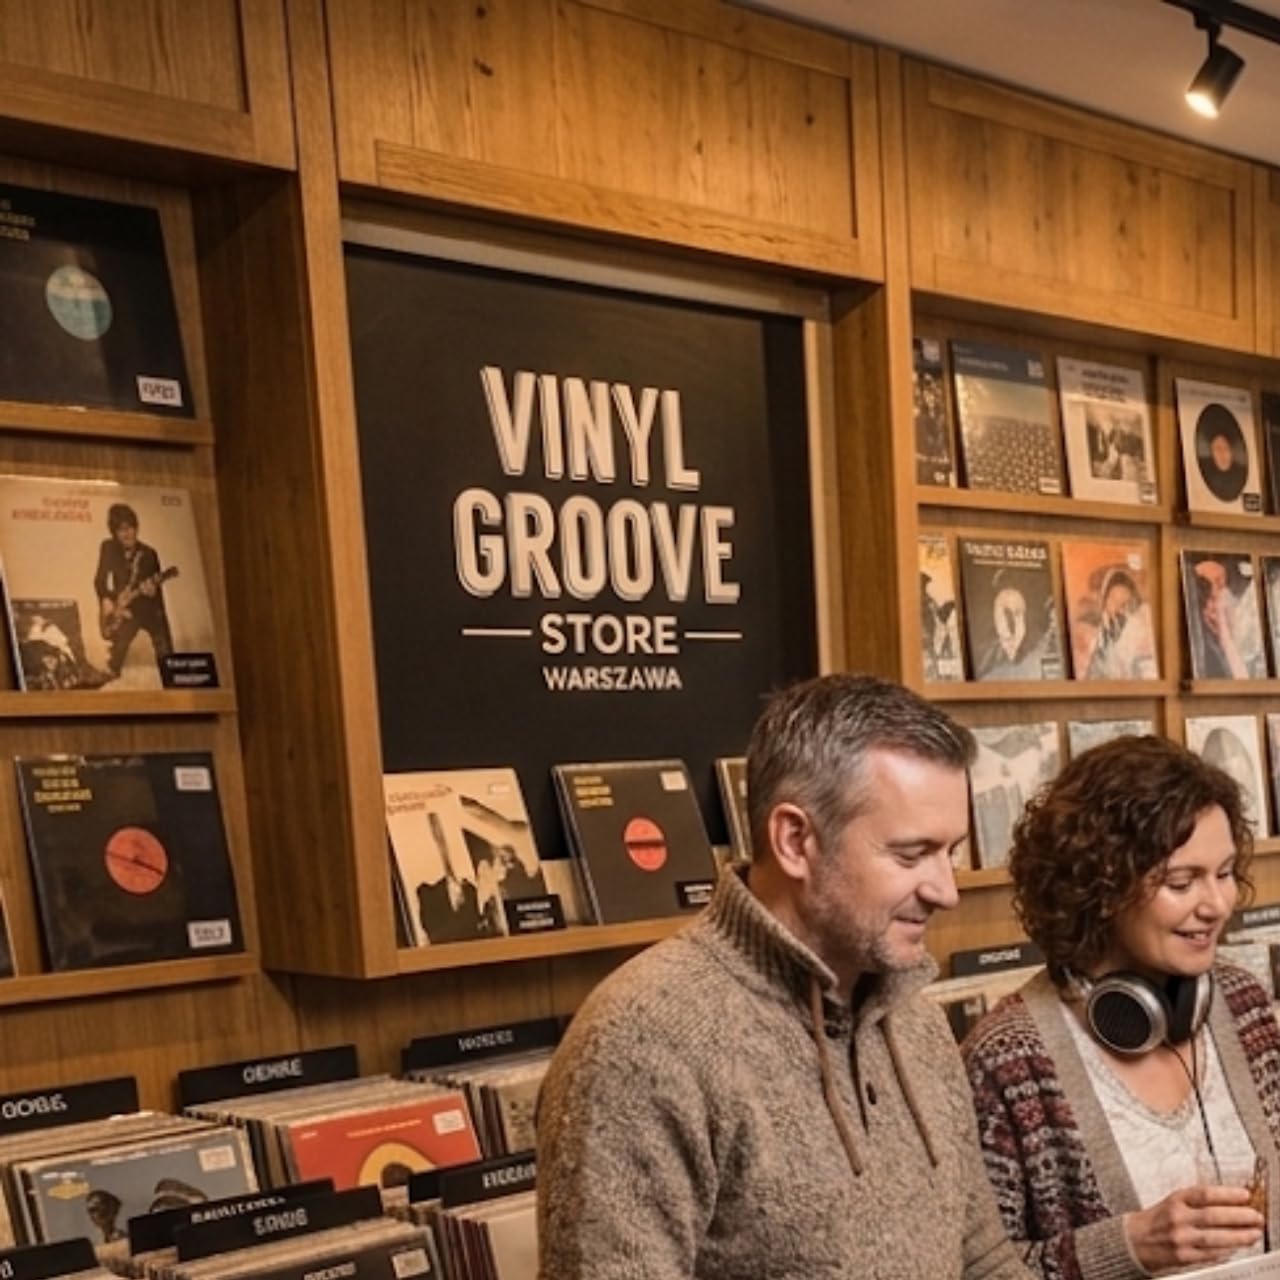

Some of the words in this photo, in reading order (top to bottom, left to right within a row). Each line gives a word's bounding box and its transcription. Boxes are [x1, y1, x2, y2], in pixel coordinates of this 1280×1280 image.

[480, 366, 700, 491] VINYL
[453, 487, 741, 604] GROOVE
[541, 613, 679, 655] STORE
[542, 665, 683, 691] WARSZAWA
